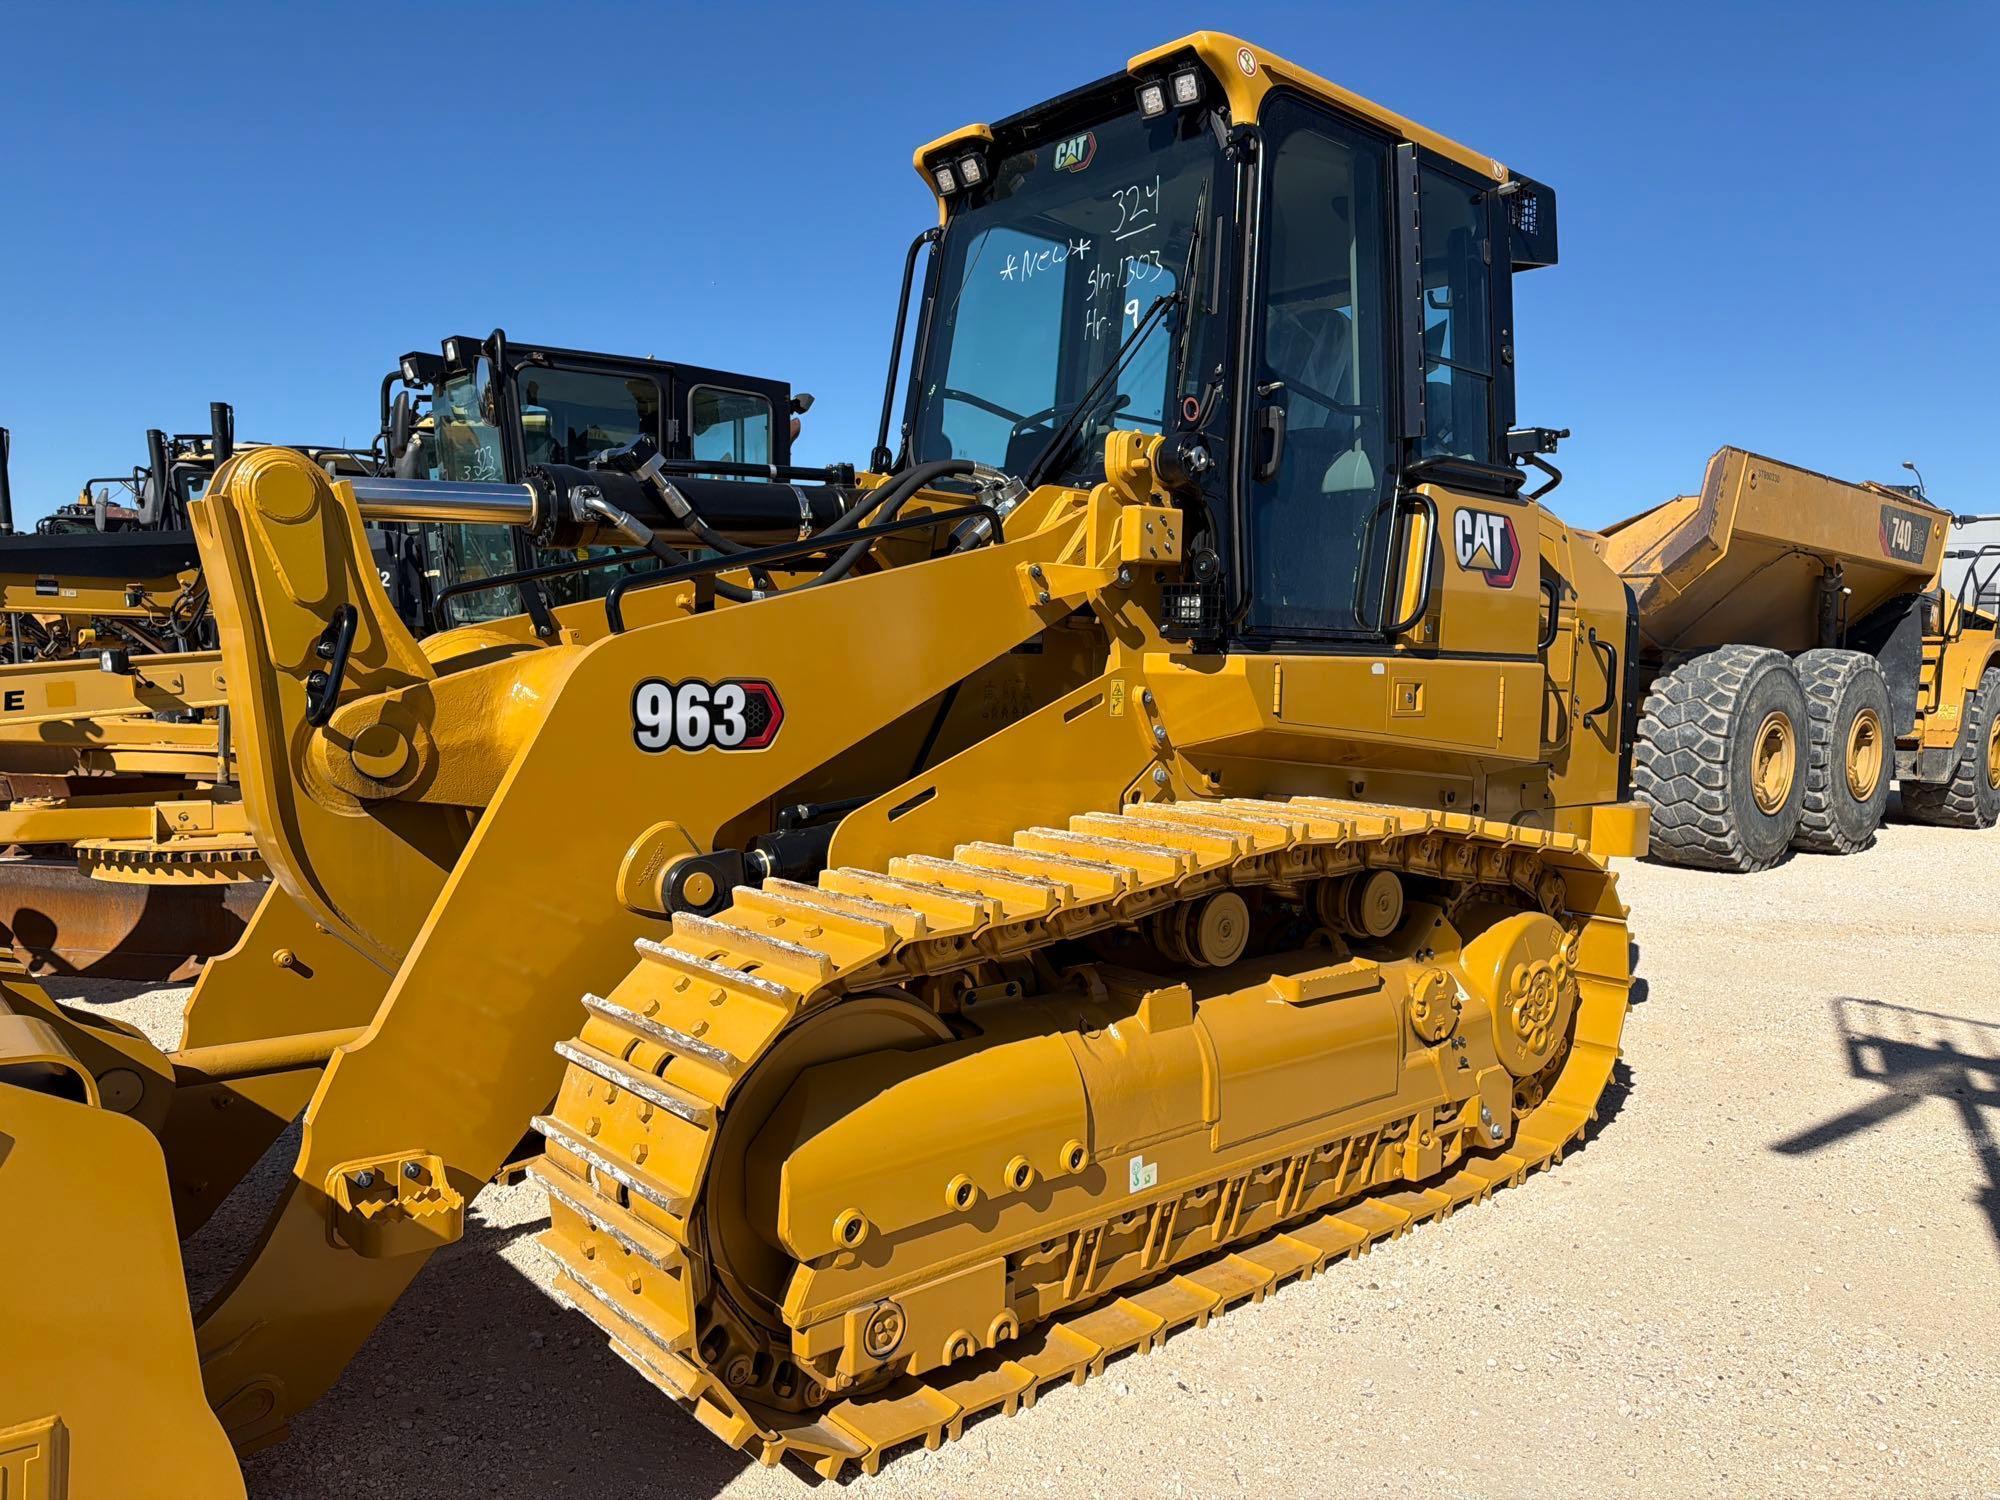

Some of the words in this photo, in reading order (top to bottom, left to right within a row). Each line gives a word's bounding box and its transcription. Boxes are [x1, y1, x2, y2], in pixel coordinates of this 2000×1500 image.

[1054, 134, 1088, 170] CAT
[1110, 174, 1160, 233] 324
[1125, 298, 1139, 329] 9
[1455, 509, 1505, 570] CAT
[1891, 517, 1912, 552] 740
[636, 683, 747, 748] 963
